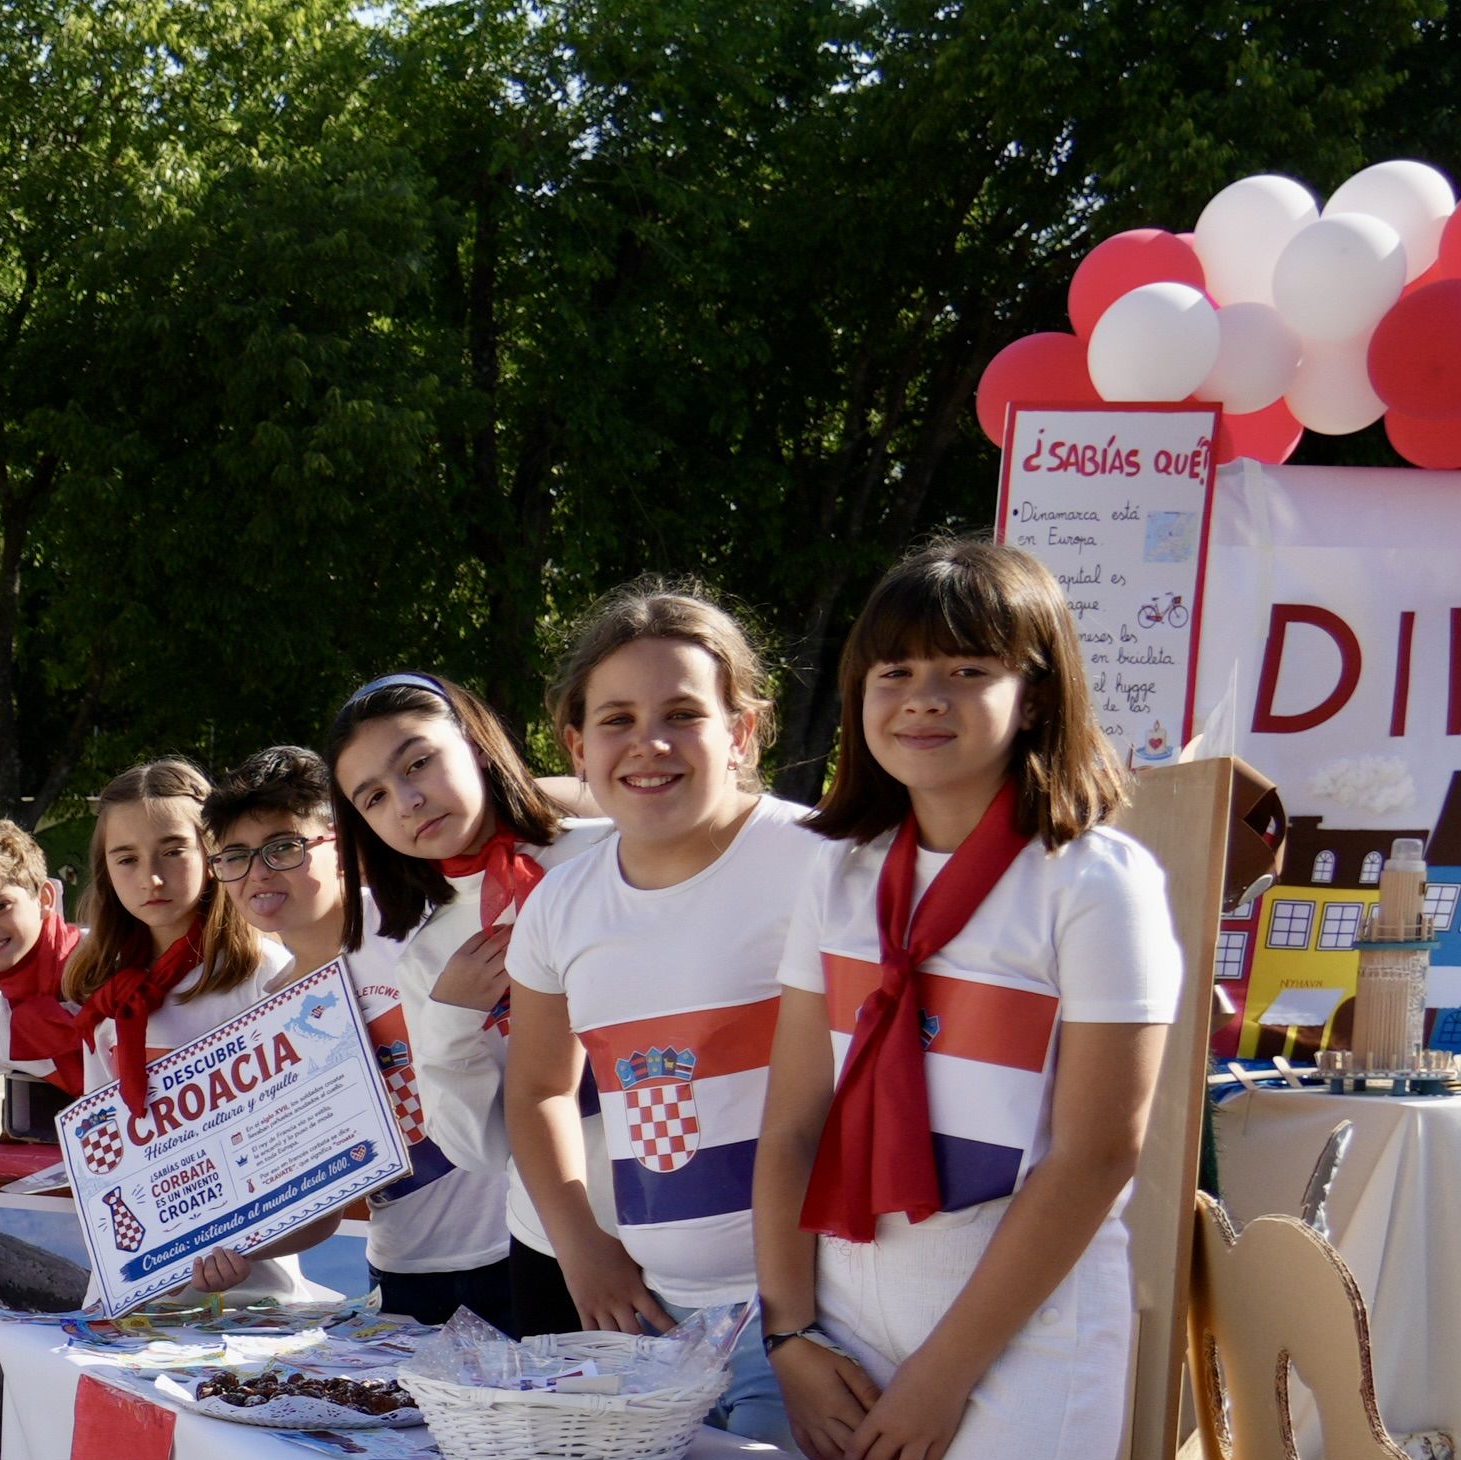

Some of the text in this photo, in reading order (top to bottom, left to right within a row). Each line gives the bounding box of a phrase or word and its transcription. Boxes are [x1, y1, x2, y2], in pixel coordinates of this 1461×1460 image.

[1023, 428, 1140, 476] ¿SABÍAS
[1021, 501, 1140, 523] Dinamarca está
[1018, 536, 1036, 546] en
[1054, 564, 1126, 592] apital es
[1078, 632, 1113, 644] neses
[1091, 654, 1110, 664] en
[1093, 672, 1156, 702] el hygge
[1103, 698, 1120, 712] de
[356, 986, 400, 1000] LETICWE
[162, 1035, 247, 1091] DESCUBRE
[126, 1032, 302, 1146] CROACIA
[144, 1071, 298, 1161] Historia, cultura y orgullo
[150, 1149, 206, 1183] ¿SABÍAS QUE LA
[151, 1158, 216, 1198] CORBATA
[155, 1172, 219, 1208] ES UN INVENTO
[159, 1182, 223, 1224] CROATA?
[142, 1156, 350, 1271] Croacia: vistiendo al mundo desde 1600.
